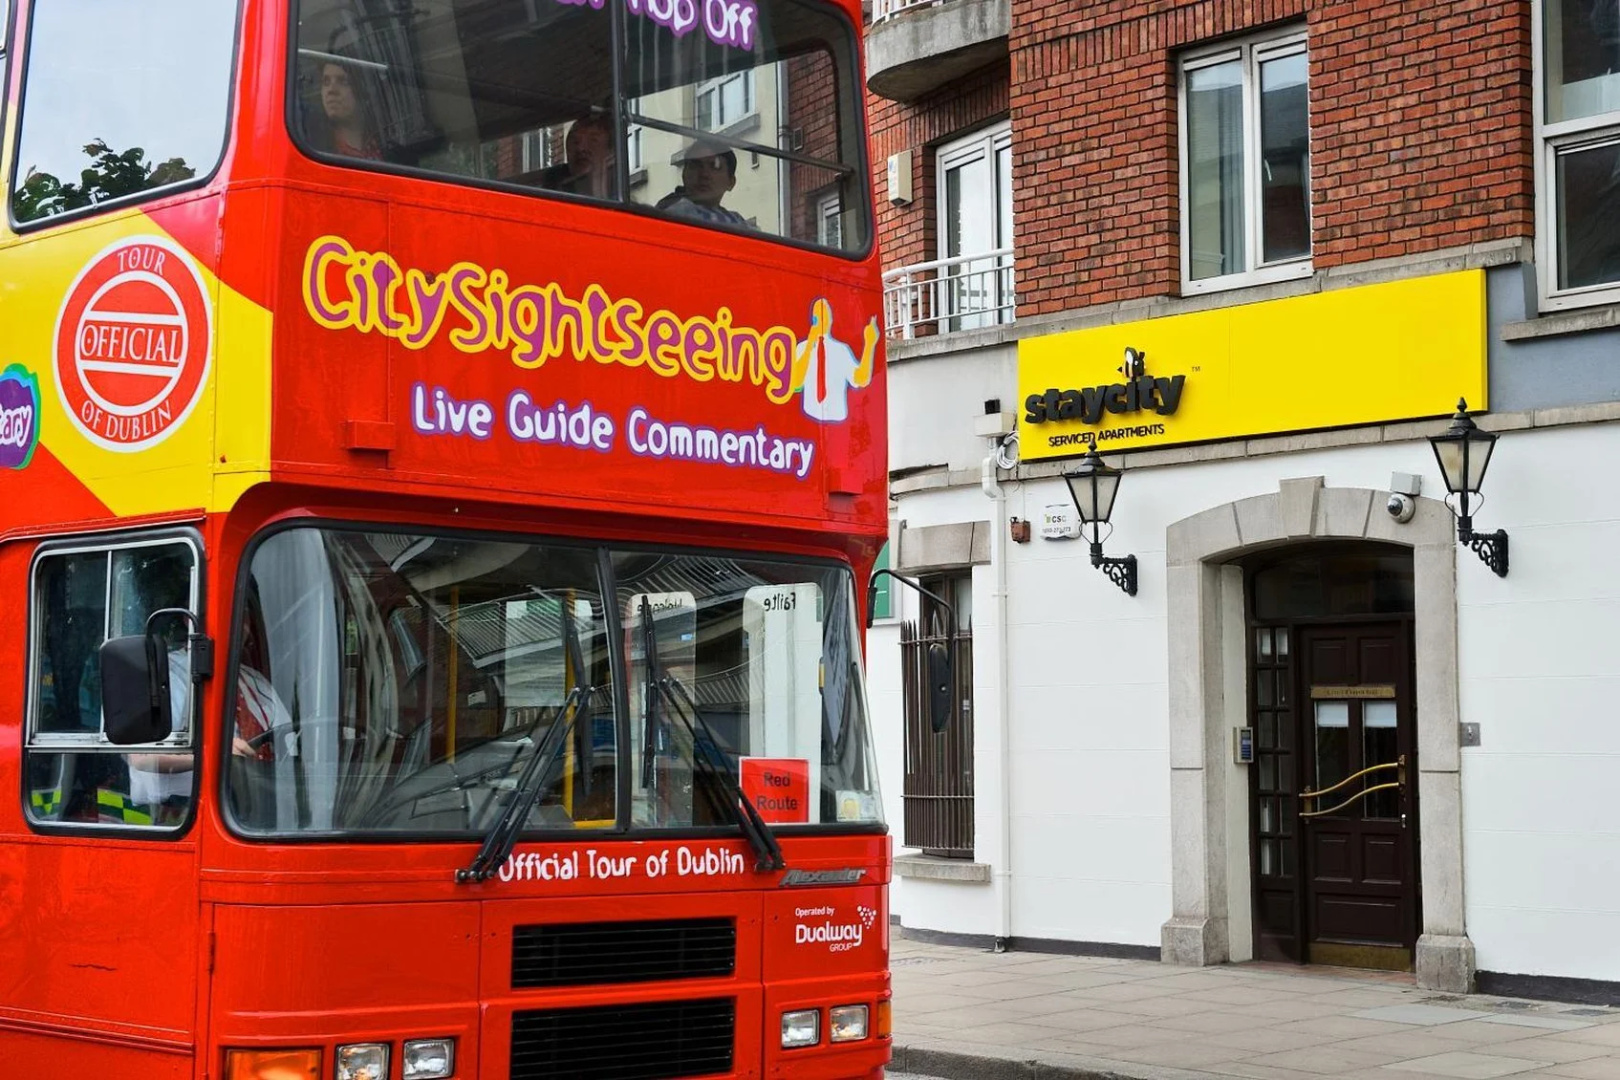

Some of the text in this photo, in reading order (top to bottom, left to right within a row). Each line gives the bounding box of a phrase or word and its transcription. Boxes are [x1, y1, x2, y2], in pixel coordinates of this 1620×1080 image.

[627, 0, 755, 46] op Off
[117, 246, 166, 276] TOUR
[302, 235, 804, 405] CitySightseeing
[80, 324, 181, 365] OFFICIAL
[1025, 374, 1186, 425] staycity
[81, 401, 172, 441] OF DUBLIN
[413, 383, 815, 478] Live Guide Commentary
[1048, 423, 1165, 447] SERVICED APARTMENTS
[763, 772, 791, 787] Red
[756, 796, 798, 810] Route
[499, 846, 745, 882] Official Tour of Dublin
[795, 907, 835, 918] Operated by
[795, 921, 863, 947] Dualway
[829, 943, 853, 952] GROUP
